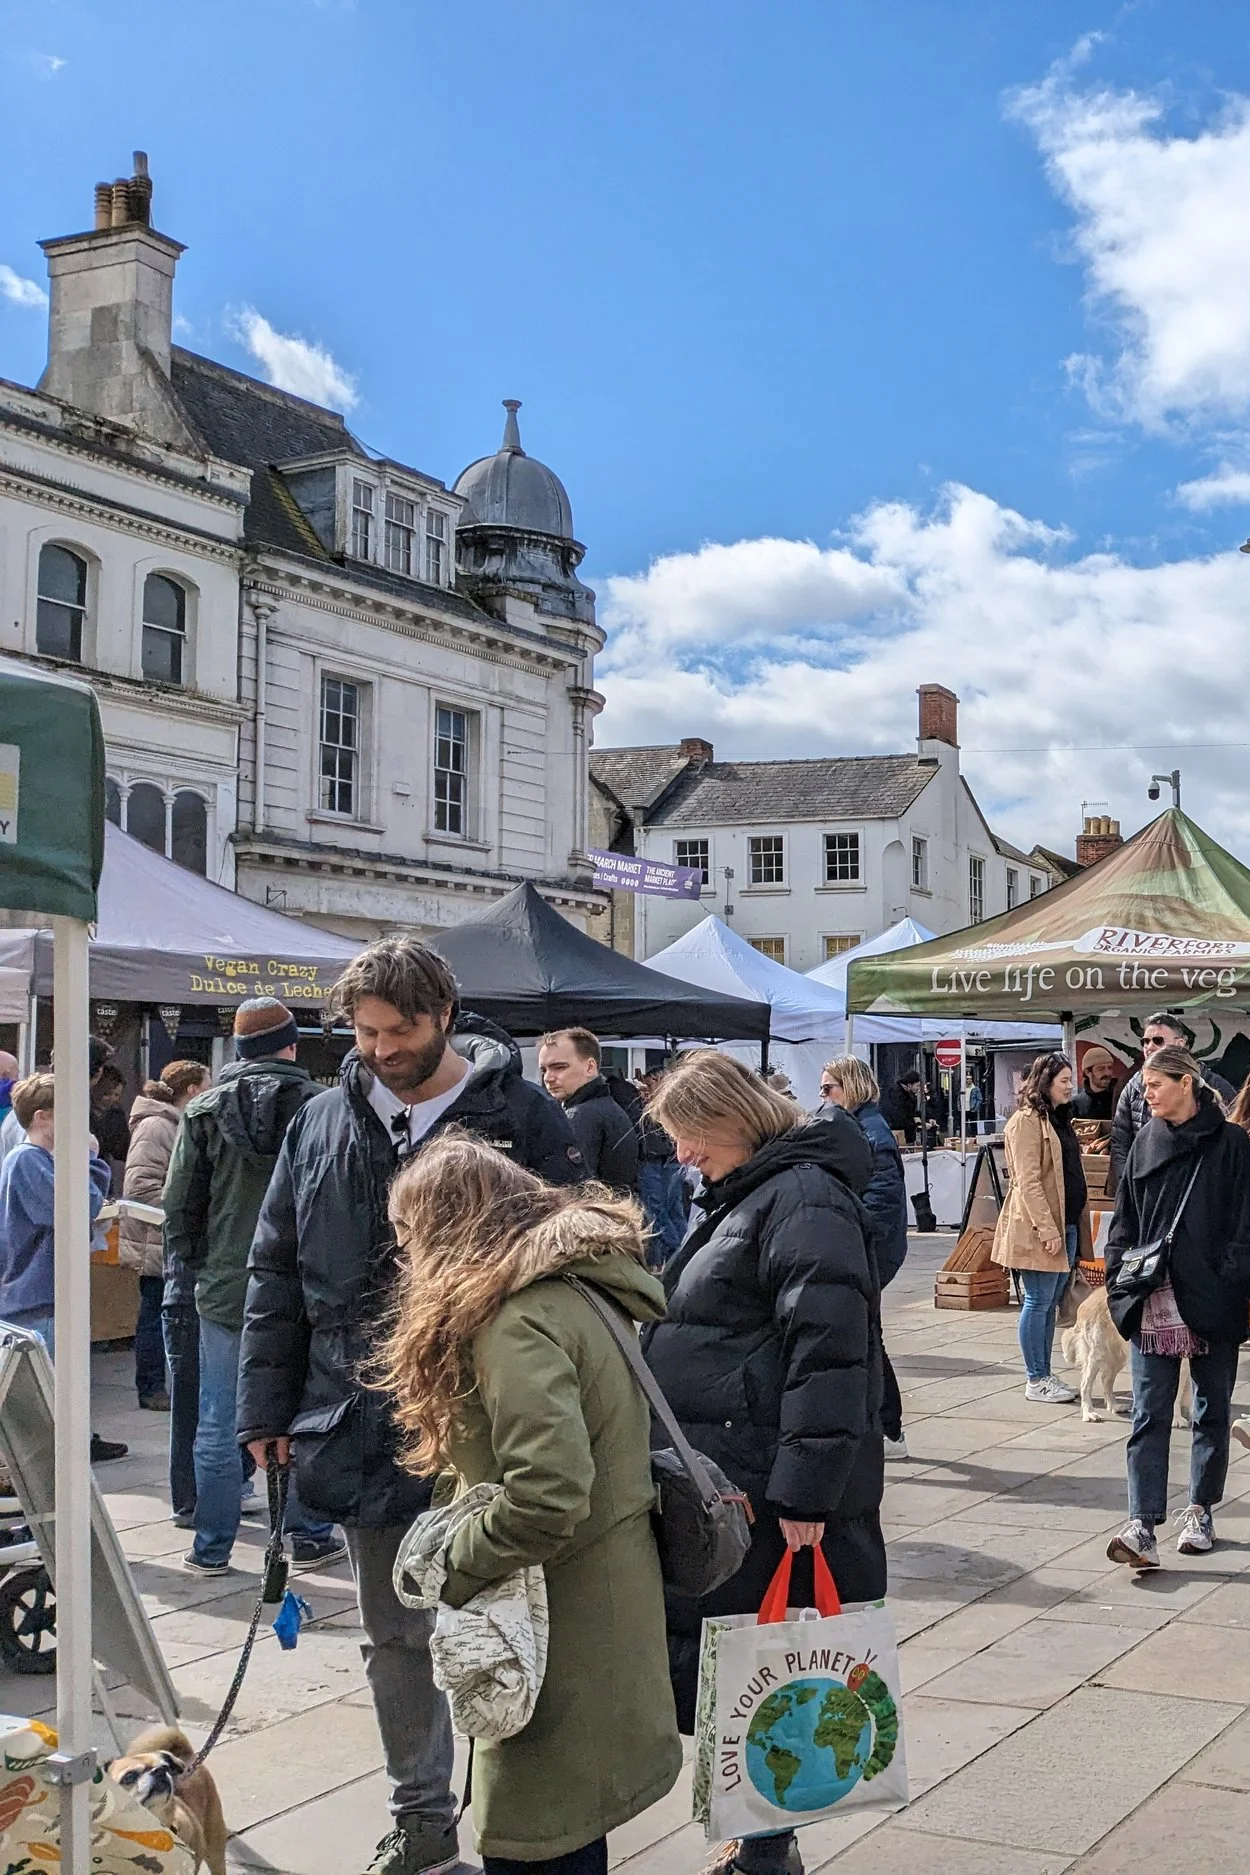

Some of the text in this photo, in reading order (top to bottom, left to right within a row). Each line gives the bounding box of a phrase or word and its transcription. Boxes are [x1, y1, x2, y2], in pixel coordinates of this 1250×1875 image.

[617, 860, 642, 875] MARKET
[1092, 943, 1233, 956] ORGANIC FARMERS
[1098, 929, 1236, 950] RIVERFORD
[204, 955, 318, 981] Vegan Crazy
[189, 974, 333, 999] Dulce de Leche
[930, 961, 1237, 1001] Live life on the veg
[720, 1649, 856, 1792] LOVE YOUR PLANET
